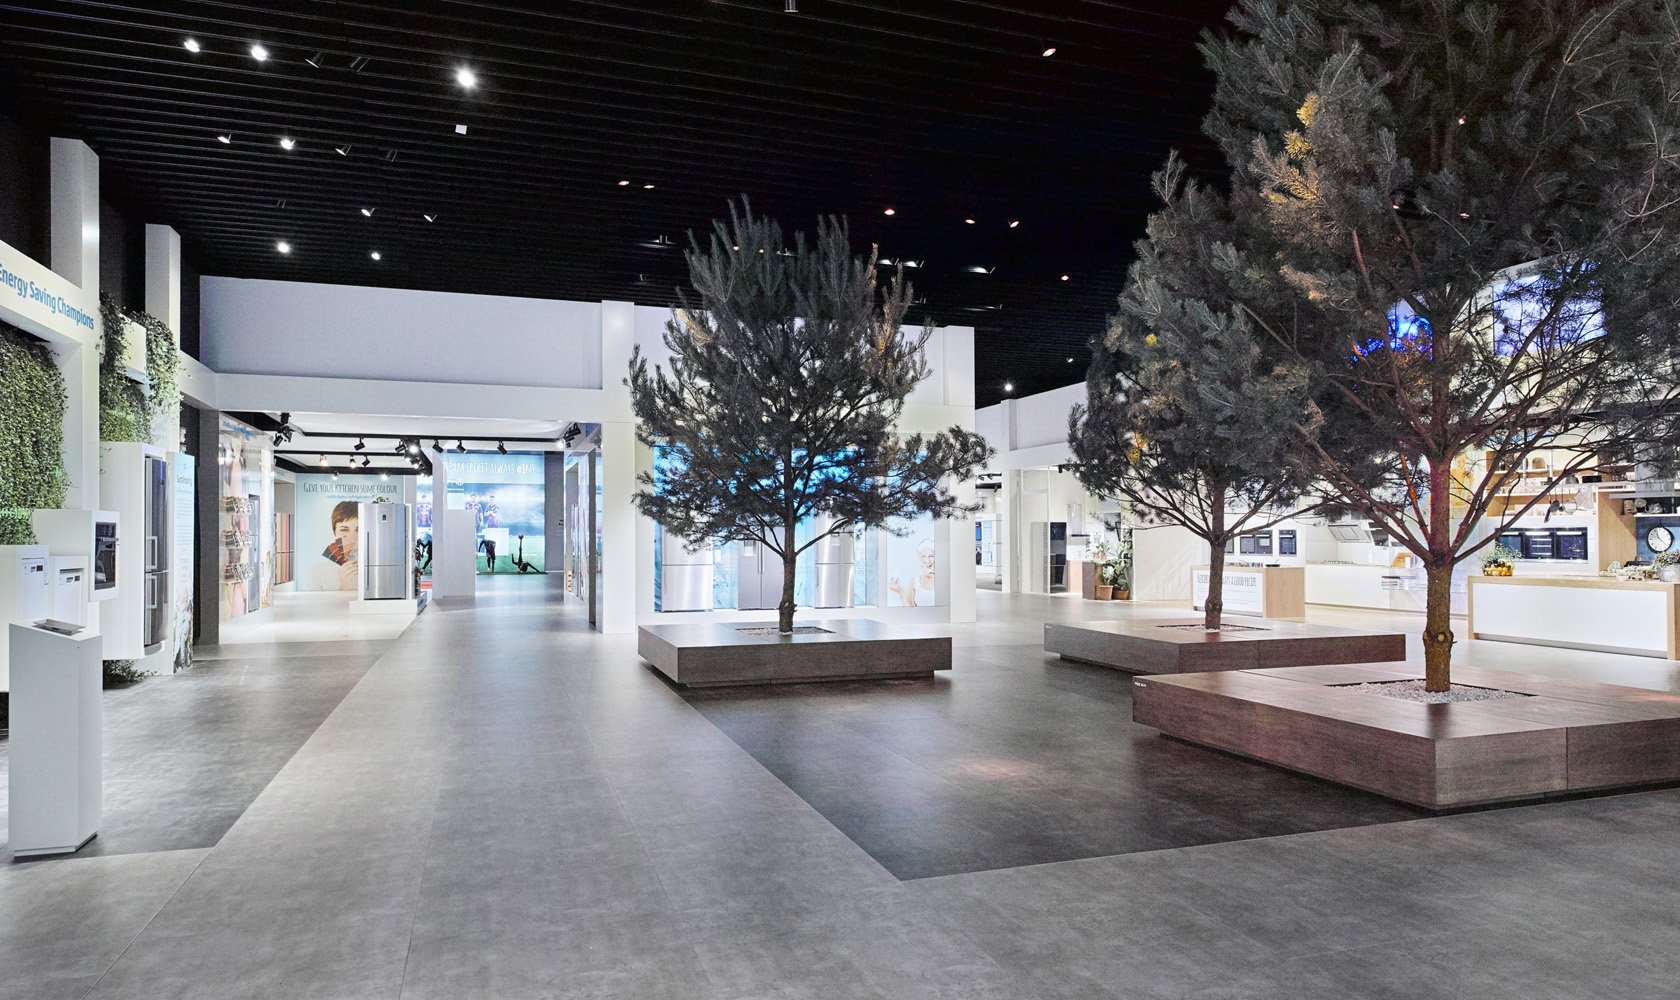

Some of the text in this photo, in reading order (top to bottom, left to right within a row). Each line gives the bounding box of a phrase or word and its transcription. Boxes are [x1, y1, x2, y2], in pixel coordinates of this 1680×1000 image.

[30, 281, 56, 314] Saving
[57, 296, 94, 330] Champions
[376, 485, 398, 493] COLOUR
